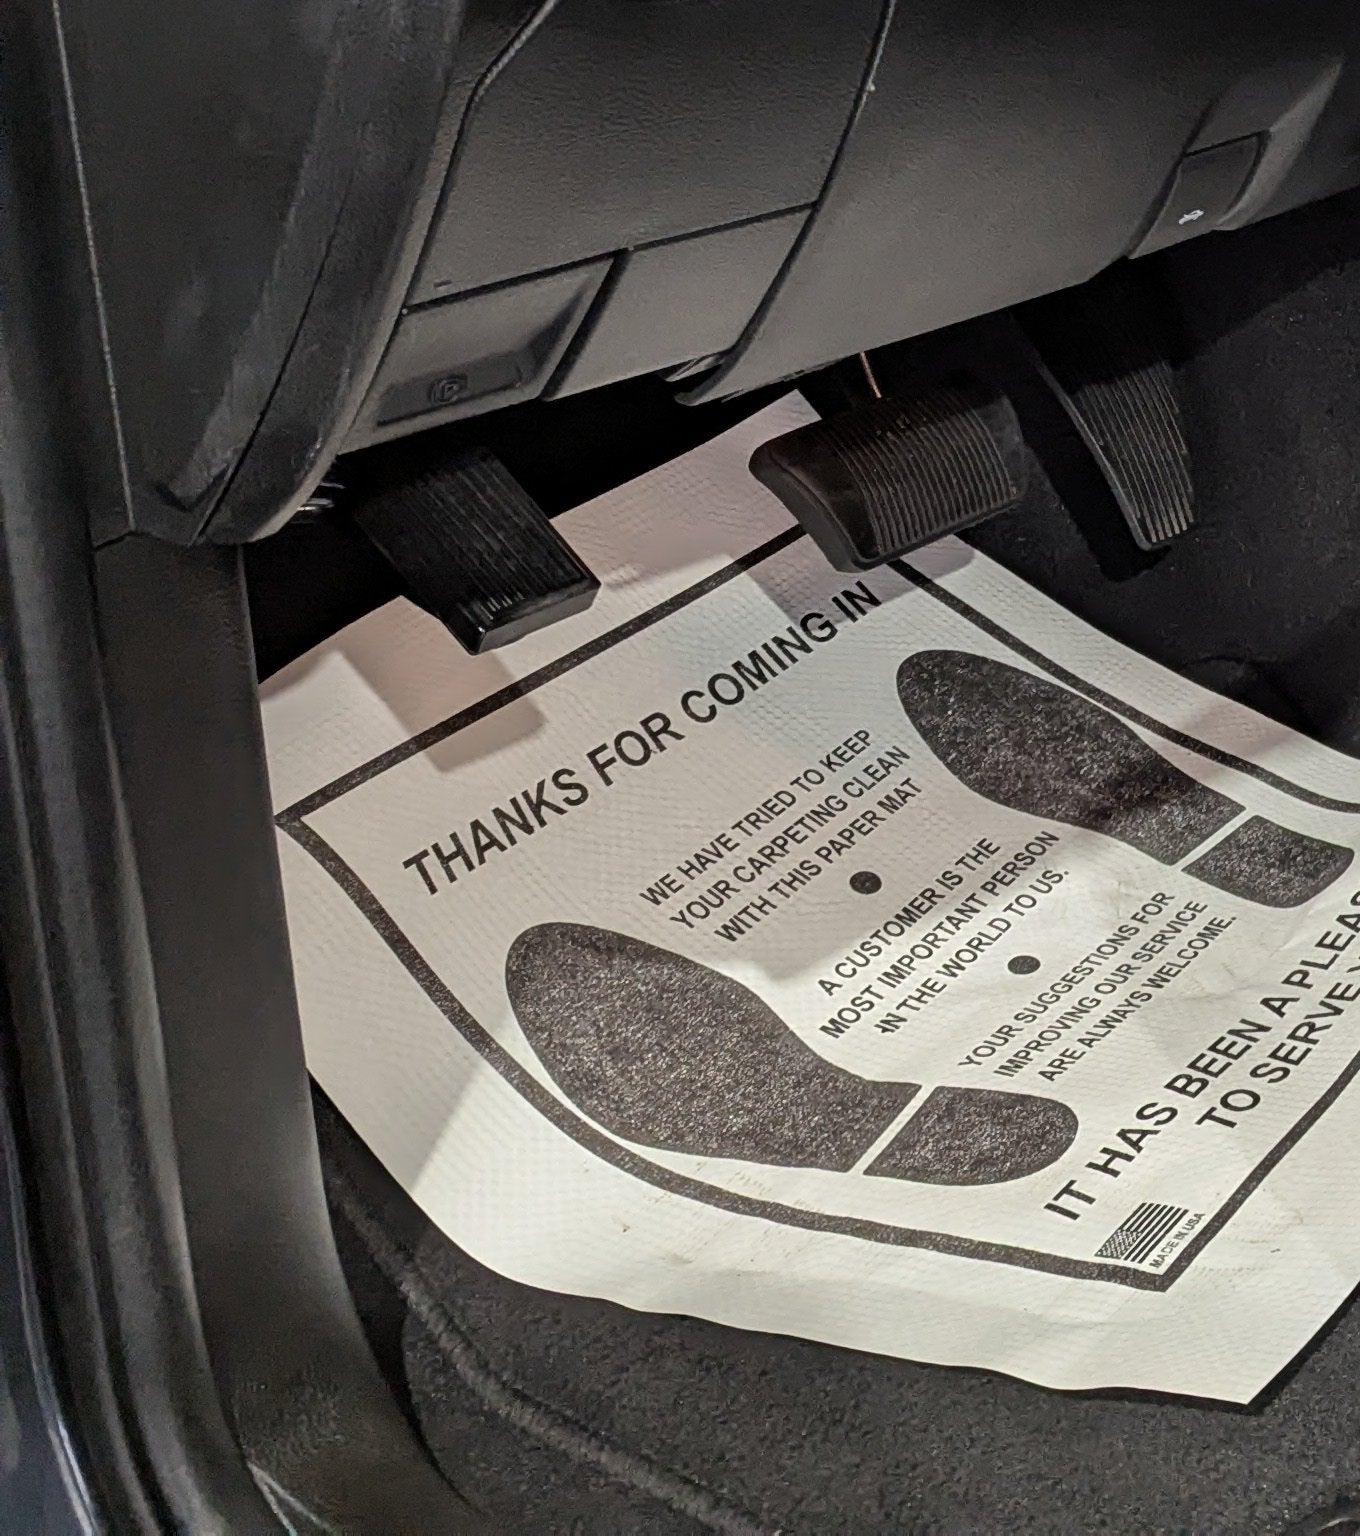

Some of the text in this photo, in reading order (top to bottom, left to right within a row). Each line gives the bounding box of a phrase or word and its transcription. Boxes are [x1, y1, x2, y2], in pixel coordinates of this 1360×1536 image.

[402, 580, 883, 895] THANKS FOR COMING IN
[638, 729, 873, 906] WE HAVE TRIED TO KEEP
[669, 746, 912, 930] YOUR CARPETING CLEAN
[713, 777, 925, 943] WITH THIS PAPER MAT
[817, 837, 1000, 997] A CUSTOMER IS THE
[819, 830, 1060, 1039] MOST IMPORTANT PERSON
[874, 868, 1070, 1035] IN THE WORLD TO US.
[957, 890, 1175, 1068] YOUR SUGGESTIONS FOR
[993, 899, 1209, 1079] IMPROVING OUR SERVICE
[1037, 915, 1237, 1083] ARE ALWAYS WELCOME.
[1043, 1179, 1097, 1221] IT
[1085, 1101, 1179, 1178] HAS
[1163, 1018, 1272, 1099] BEEN
[1259, 992, 1301, 1019] A
[1195, 1088, 1261, 1131] TO
[1148, 1213, 1206, 1269] MADE IN USA
